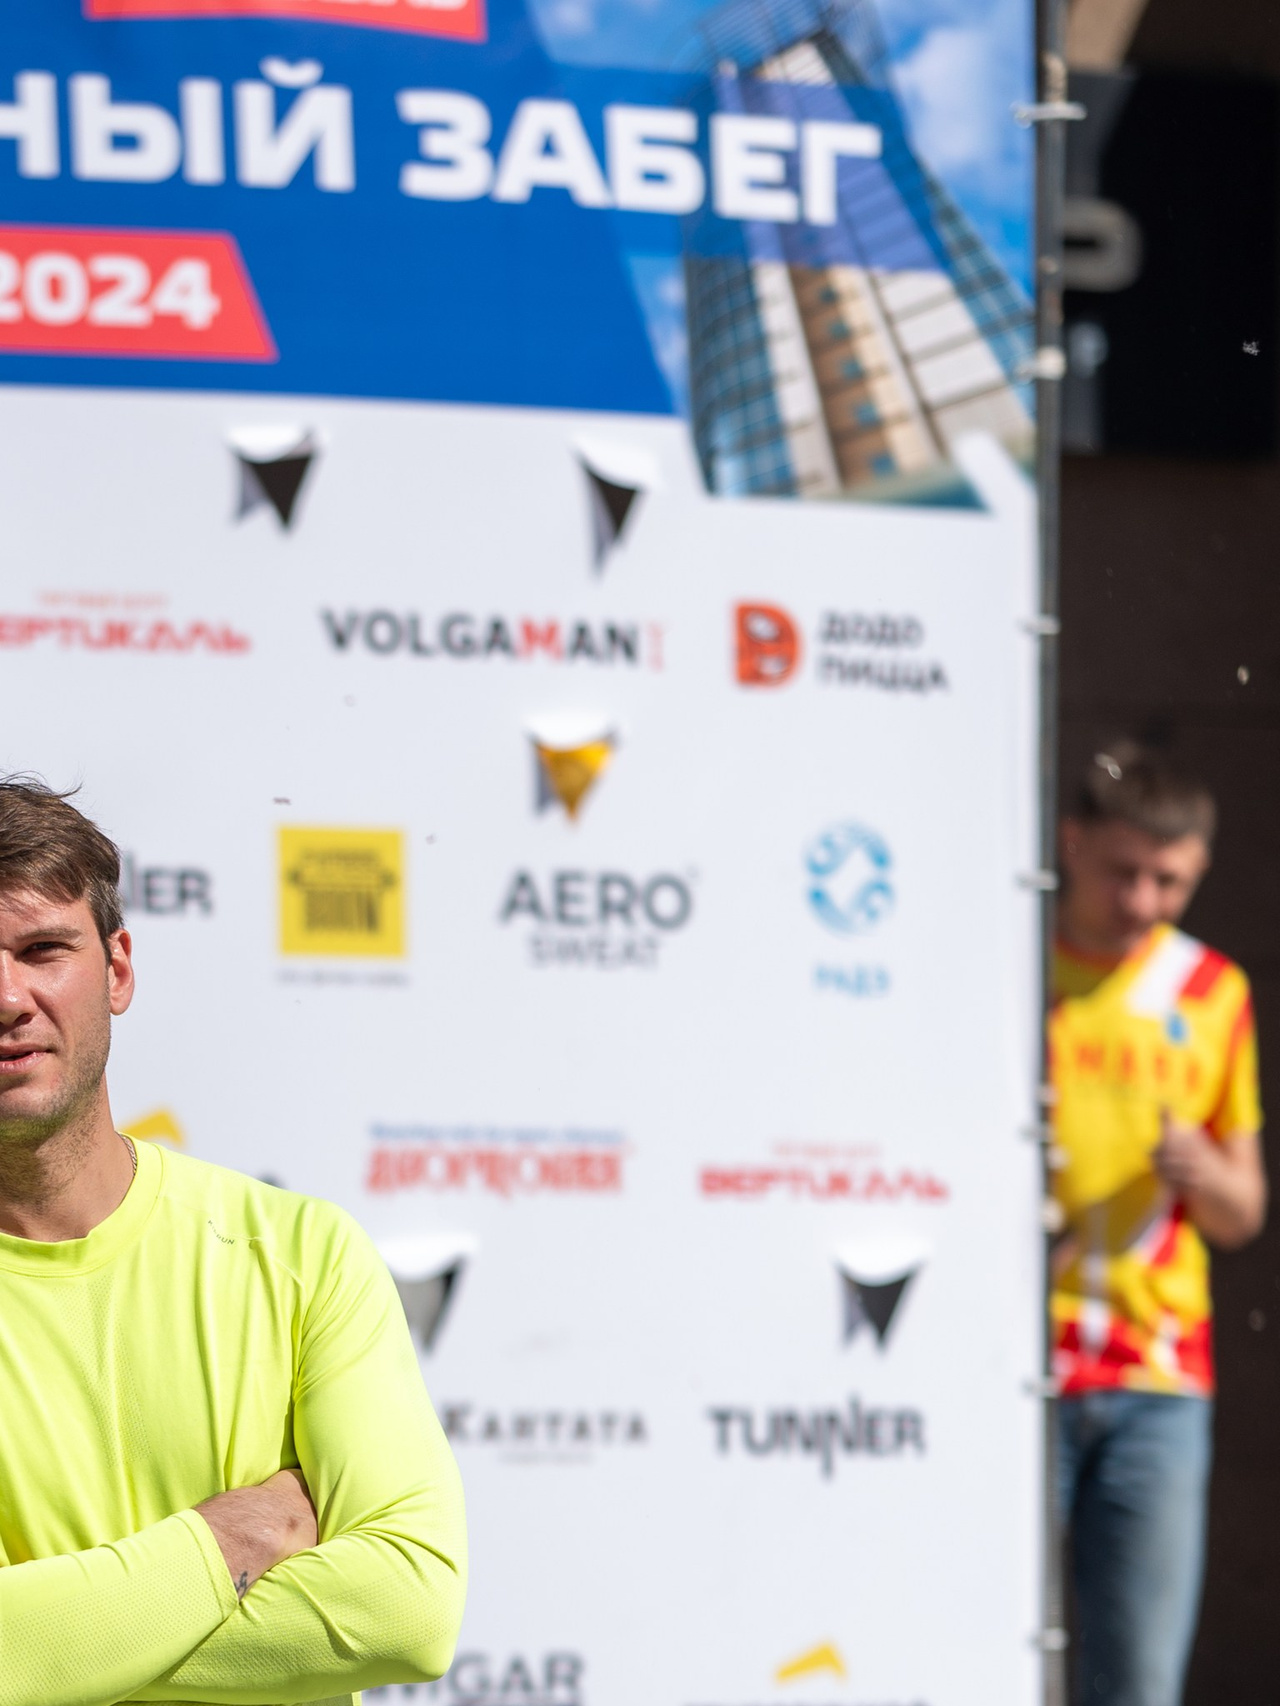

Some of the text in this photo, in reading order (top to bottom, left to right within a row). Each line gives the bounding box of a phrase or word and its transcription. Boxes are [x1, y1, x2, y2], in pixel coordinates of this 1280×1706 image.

[396, 86, 883, 226] ЗАБЕГ
[318, 605, 645, 667] VOLGAMAN
[816, 605, 926, 650] ДОДО
[498, 866, 696, 932] AERO
[528, 934, 665, 972] SWEAT
